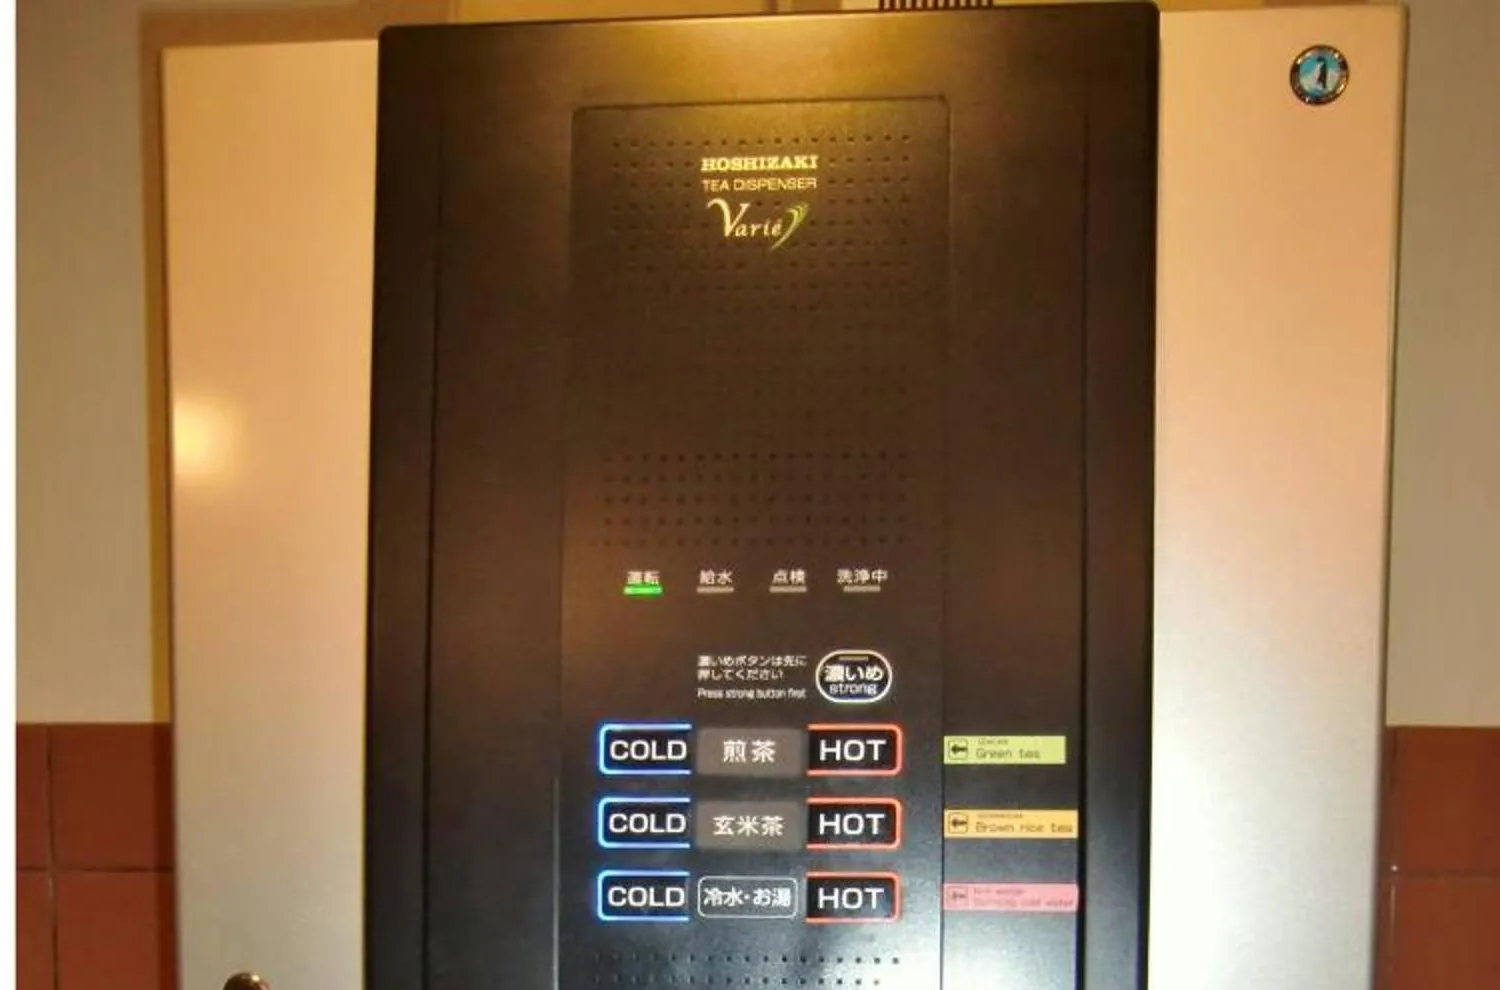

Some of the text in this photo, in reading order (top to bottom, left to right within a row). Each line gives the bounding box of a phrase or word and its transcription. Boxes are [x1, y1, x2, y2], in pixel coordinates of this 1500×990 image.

[701, 155, 819, 172] HOSHIZAKI
[702, 177, 817, 192] TEA DISPENSER
[700, 569, 733, 584] 給水
[772, 569, 806, 584] 点検
[837, 569, 888, 584] 洗浄中
[697, 669, 784, 681] 押してください
[725, 688, 755, 699] strong
[829, 683, 878, 697] strong
[609, 740, 687, 761] COLD
[722, 739, 776, 763] 煎茶
[819, 739, 886, 762] HOT
[608, 813, 687, 833] COLD
[712, 814, 785, 837] 玄米茶
[818, 813, 885, 836] HOT
[607, 886, 685, 908] COLD
[817, 887, 884, 909] HOT
